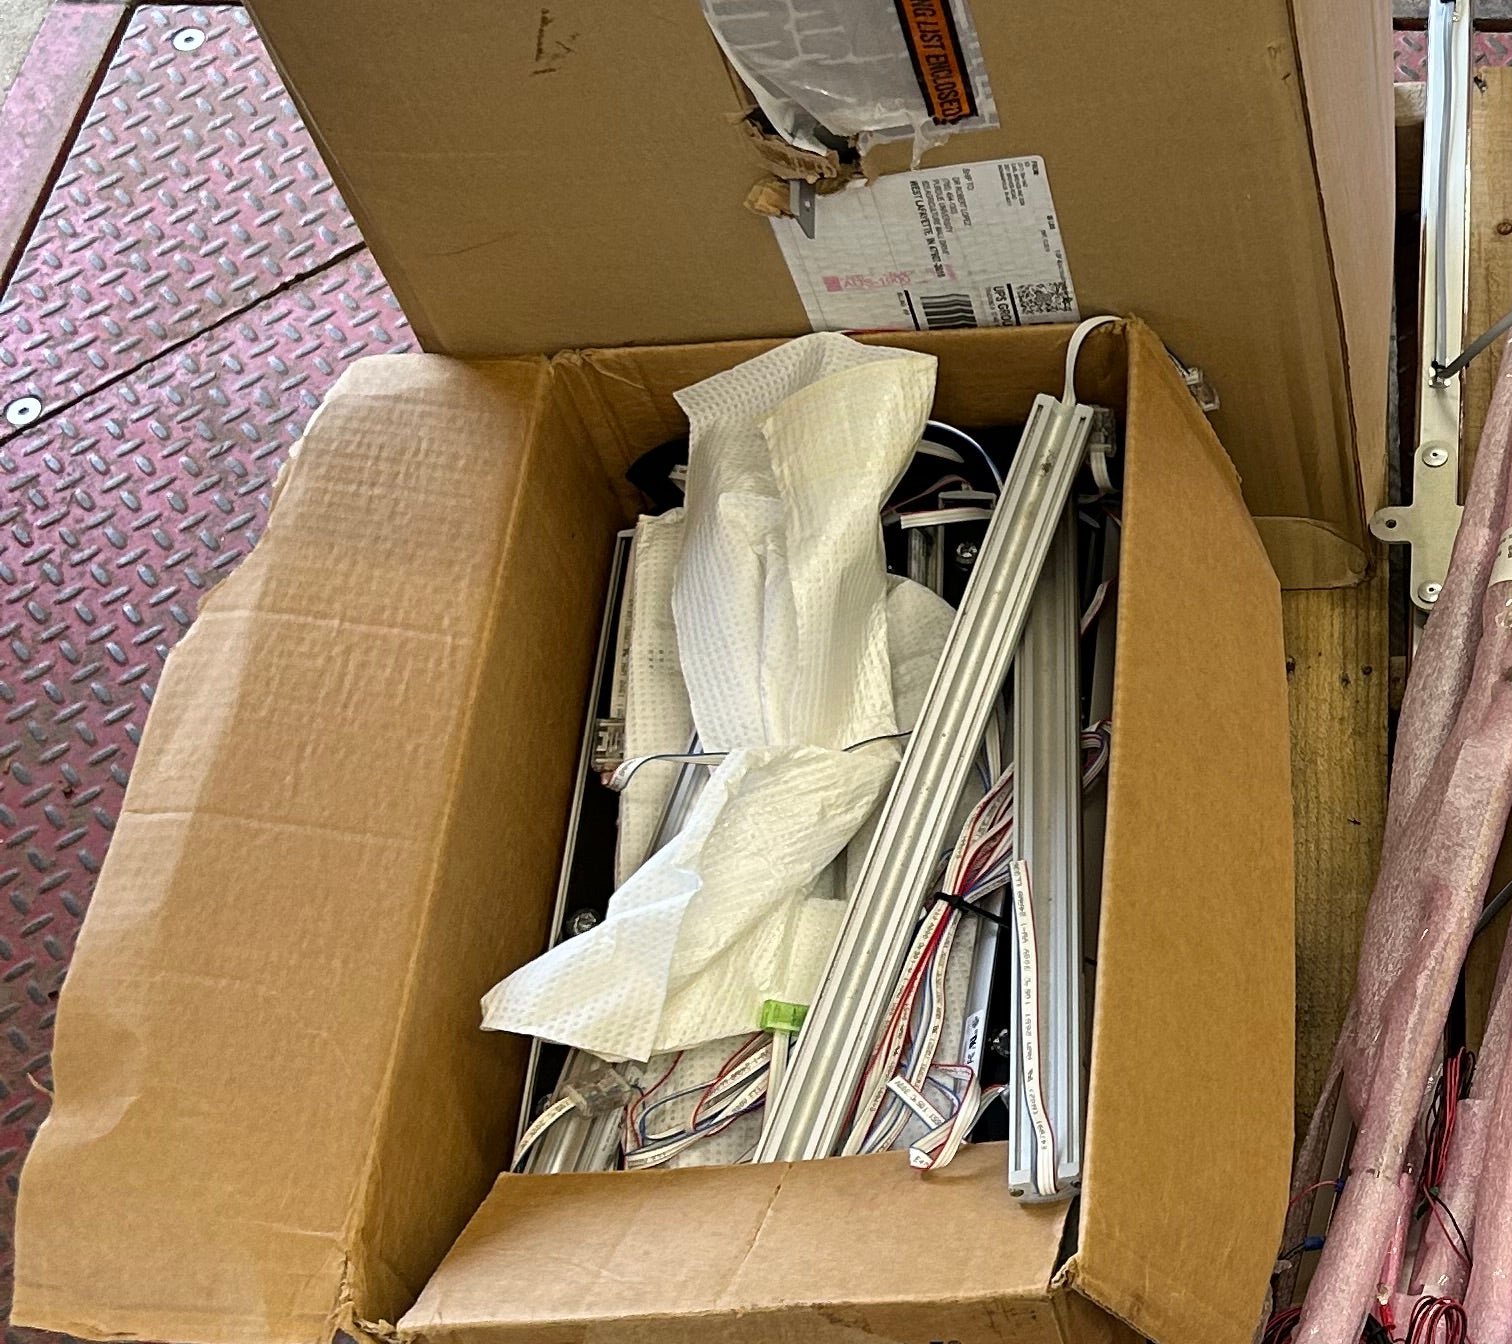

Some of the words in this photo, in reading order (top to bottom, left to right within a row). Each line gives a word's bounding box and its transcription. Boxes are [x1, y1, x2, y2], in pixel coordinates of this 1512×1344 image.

[916, 17, 945, 50] LIST
[924, 52, 963, 118] ENCLOSED
[909, 180, 922, 198] WEST
[915, 199, 933, 235] LAFAYETTE
[992, 285, 1007, 301] UPS
